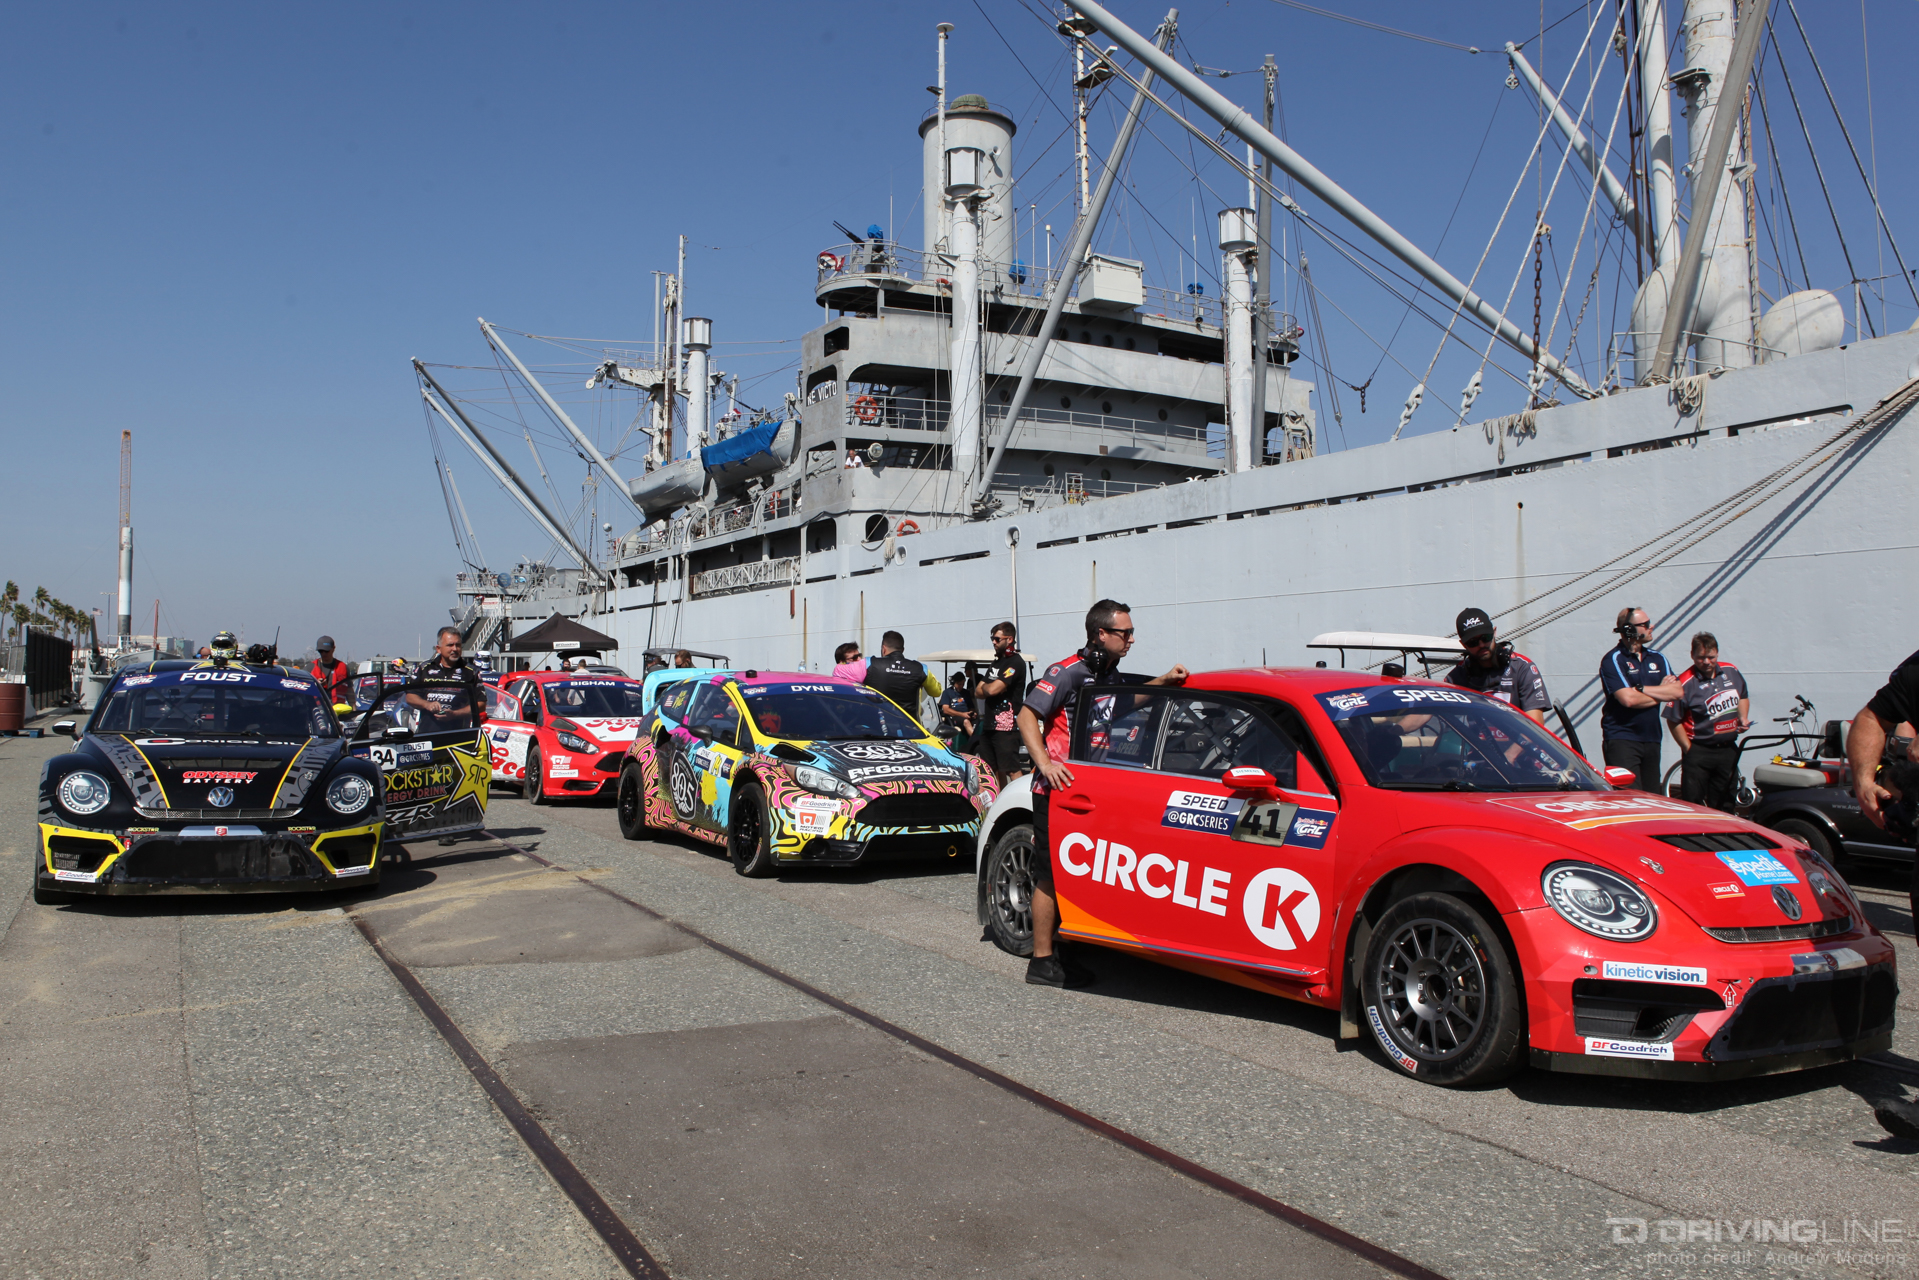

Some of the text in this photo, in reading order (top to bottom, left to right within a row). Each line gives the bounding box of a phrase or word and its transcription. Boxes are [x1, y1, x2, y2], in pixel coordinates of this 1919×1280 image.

[808, 381, 837, 405] NE VICTO
[180, 672, 257, 683] FOUST
[1393, 690, 1471, 704] SPEED
[1709, 696, 1739, 715] Oberto
[372, 749, 394, 767] 34
[843, 745, 917, 759] 805
[182, 771, 259, 780] ODYSSEY
[848, 765, 960, 780] BFGoodrich
[416, 785, 446, 799] DRINK
[671, 762, 695, 812] 805
[1180, 794, 1230, 811] SPEED
[1535, 801, 1653, 813] CIRCLE
[1167, 810, 1230, 831] @GRCSERIES
[1239, 805, 1282, 840] 41
[1728, 853, 1788, 879] expedite
[1058, 831, 1311, 949] CIRCLE K
[1369, 1006, 1418, 1072] BFGoodrich
[1591, 1041, 1668, 1053] BFGoodrich
